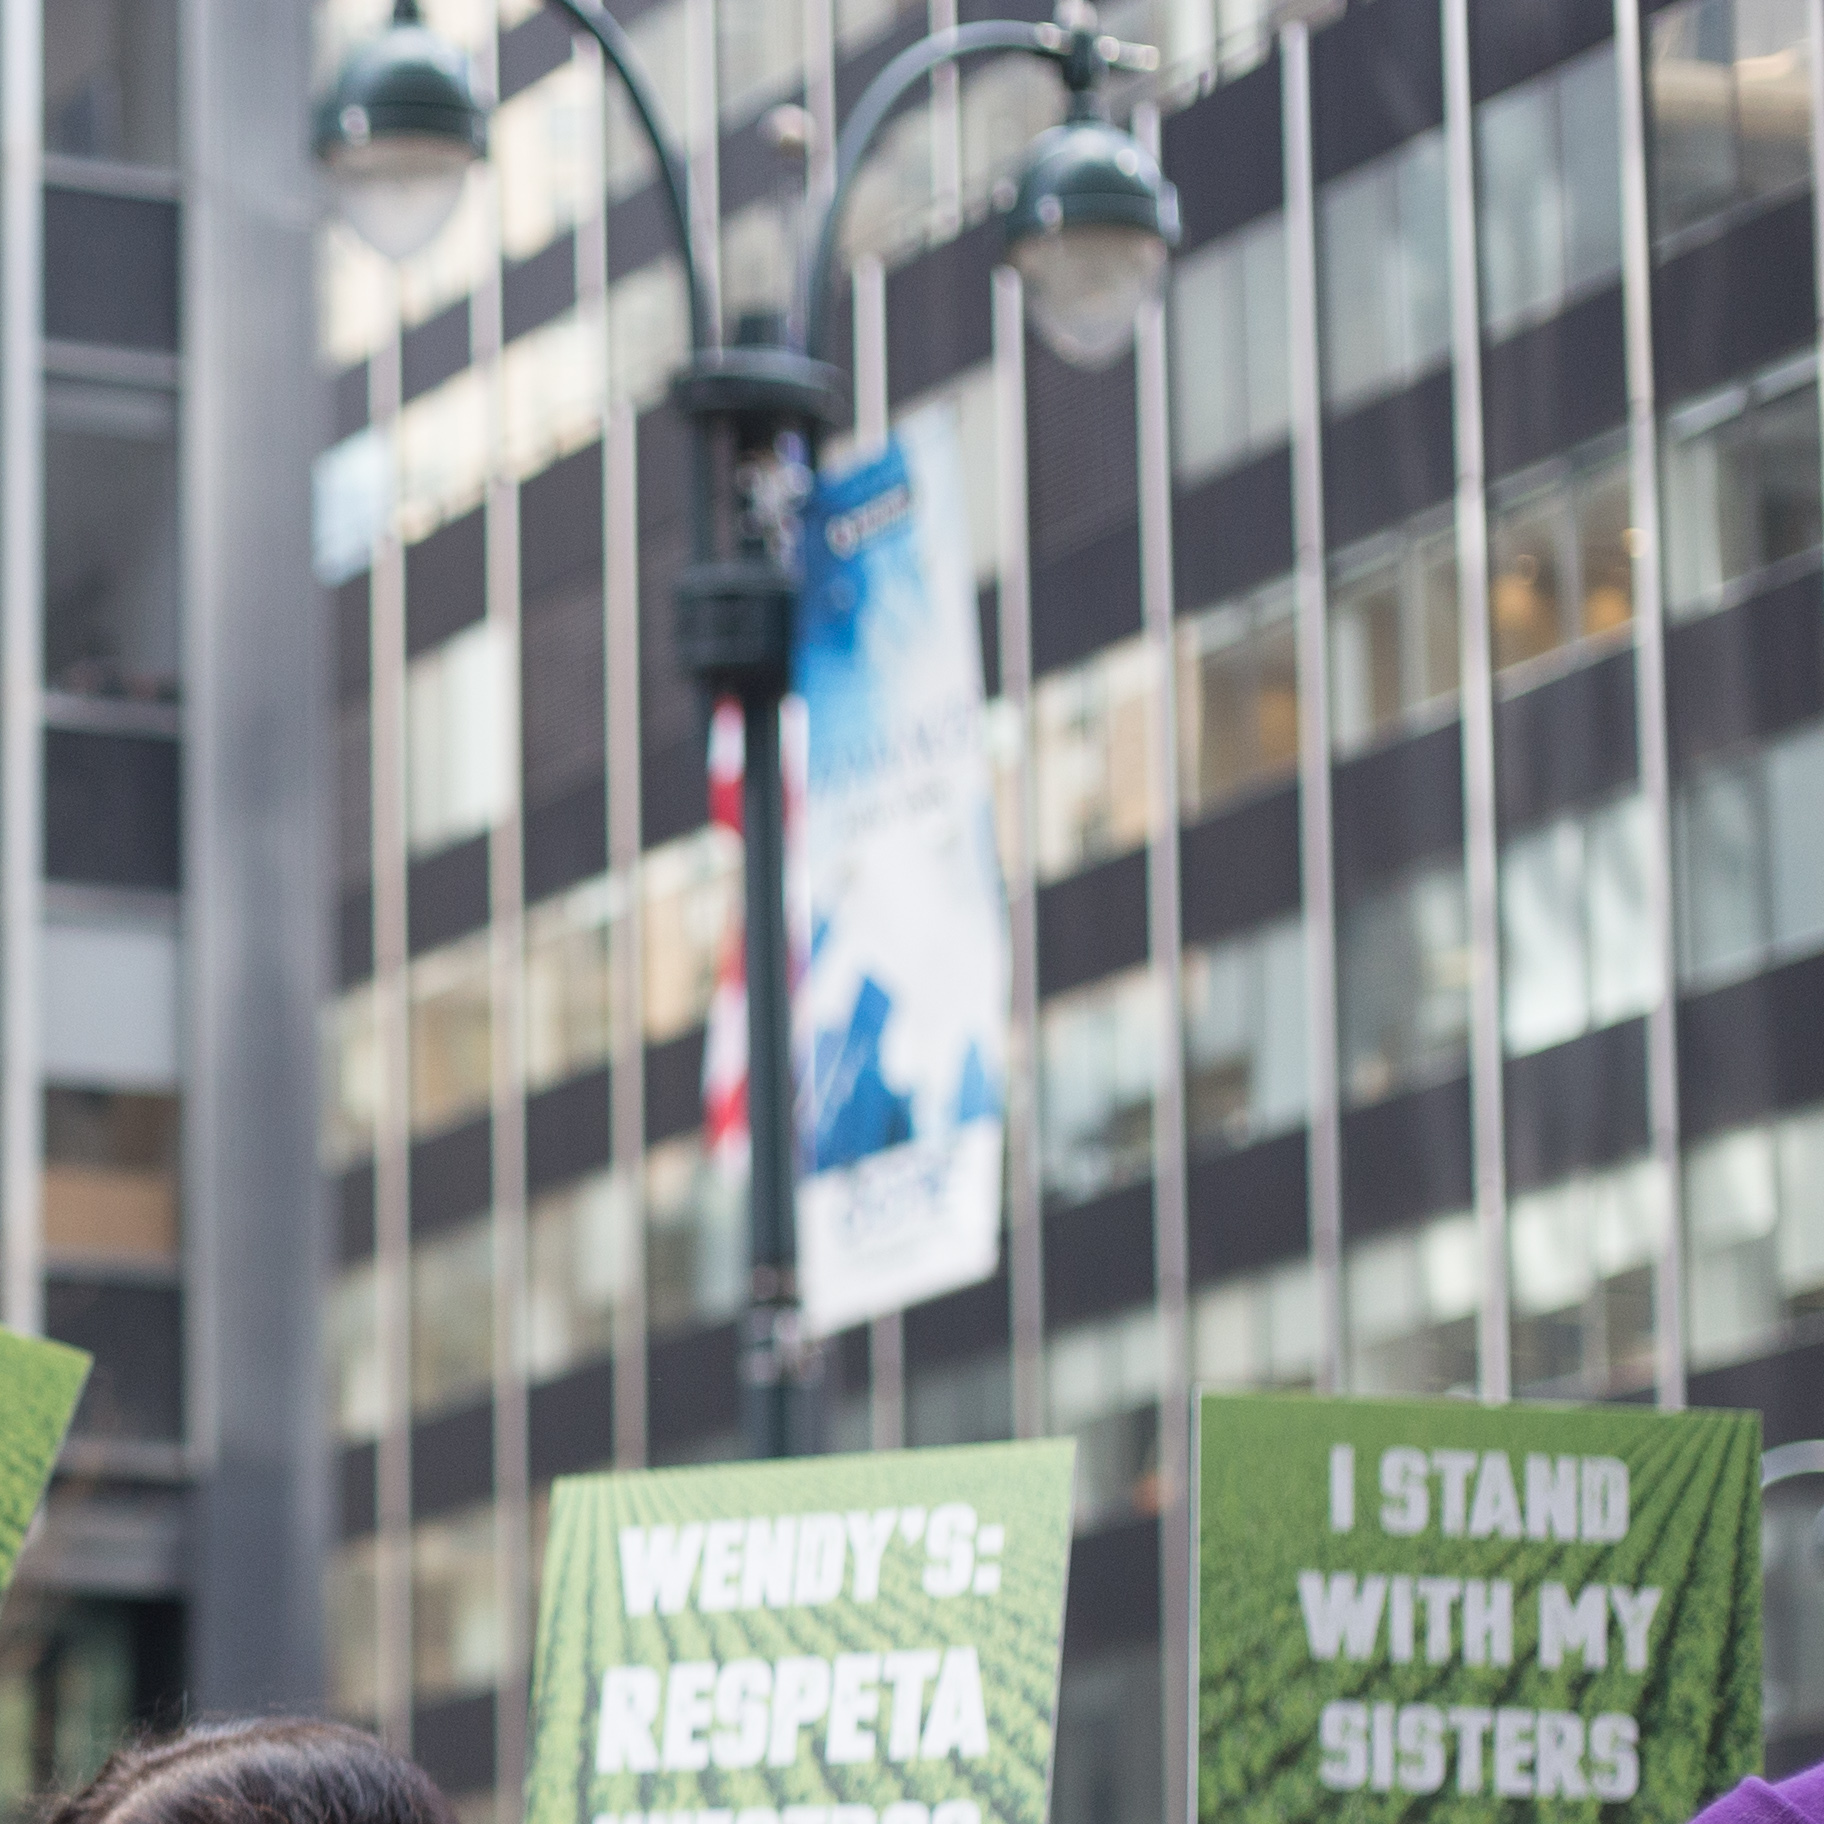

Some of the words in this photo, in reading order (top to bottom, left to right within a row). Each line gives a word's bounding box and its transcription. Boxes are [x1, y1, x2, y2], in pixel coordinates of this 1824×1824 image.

[1328, 1442, 1355, 1534] I
[1379, 1444, 1632, 1545] STAND
[618, 1501, 1005, 1617] WENDY'S:
[1297, 1568, 1514, 1669] WITH
[1538, 1580, 1664, 1674] MY
[595, 1645, 990, 1775] RESPETA
[1318, 1700, 1640, 1804] SISTERS
